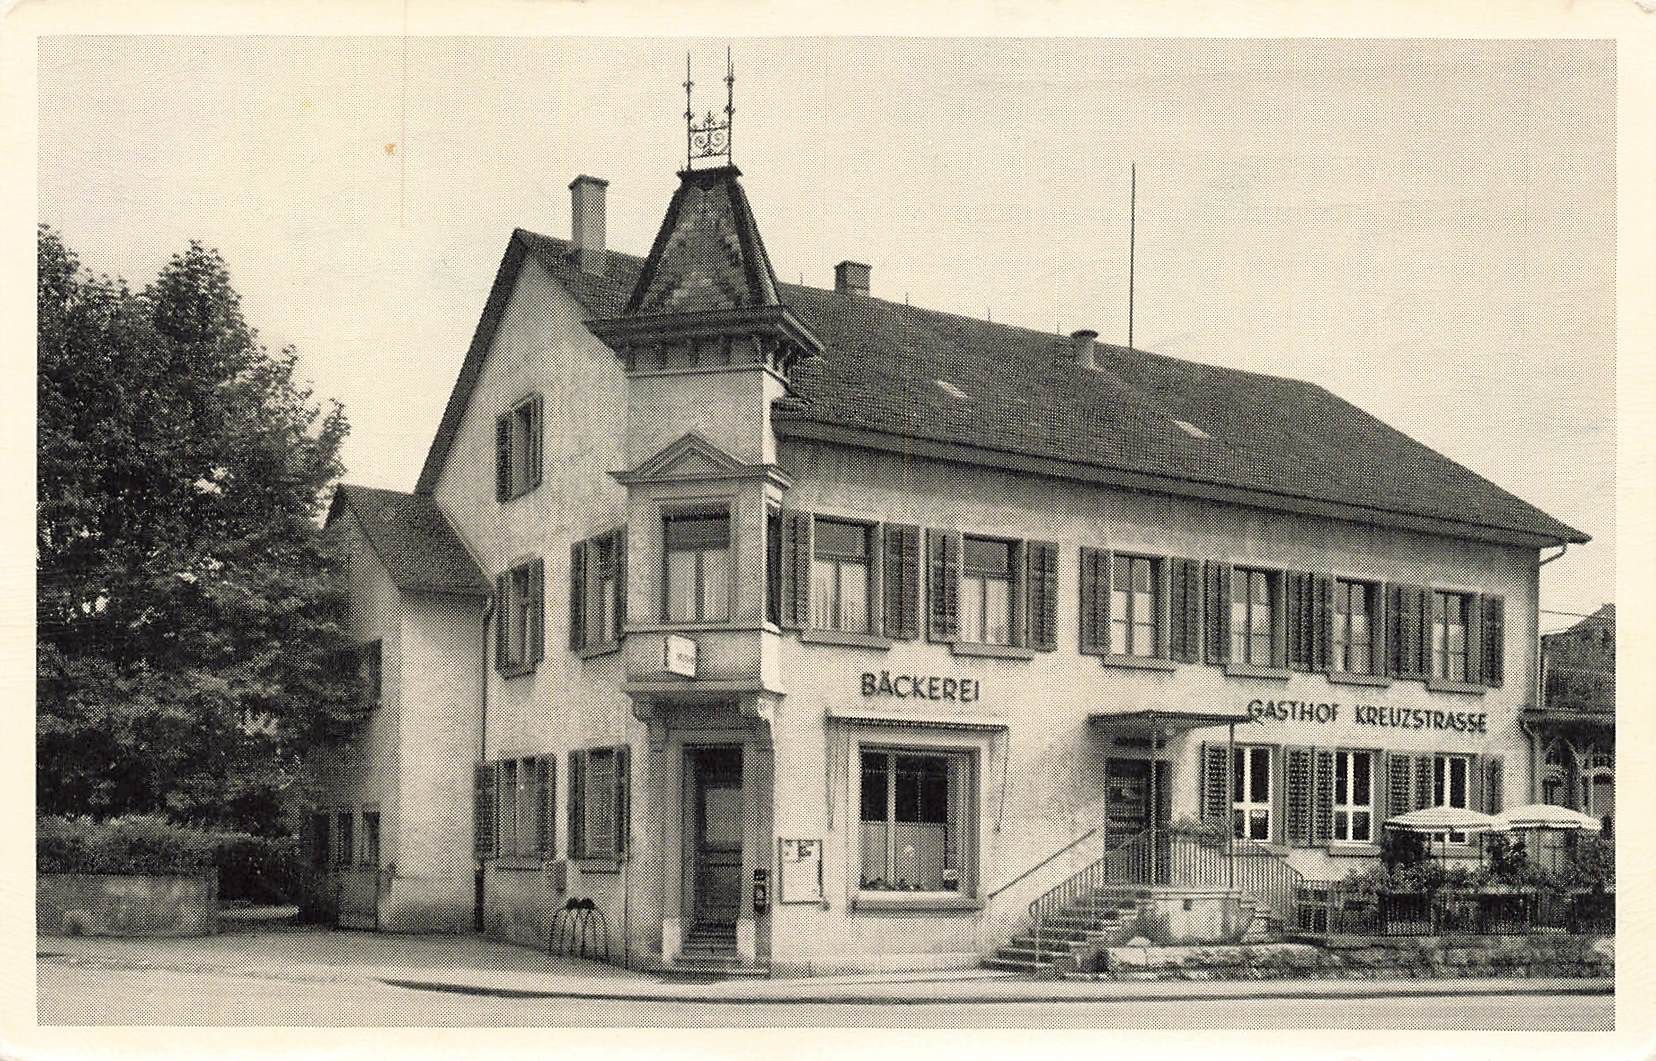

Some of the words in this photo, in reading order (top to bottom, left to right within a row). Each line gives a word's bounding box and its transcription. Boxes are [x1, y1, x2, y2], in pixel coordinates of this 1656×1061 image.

[861, 670, 979, 702] BÄCKEREI
[1247, 699, 1339, 723] GASTHOF
[1355, 704, 1487, 733] KREUZSTRASSE
